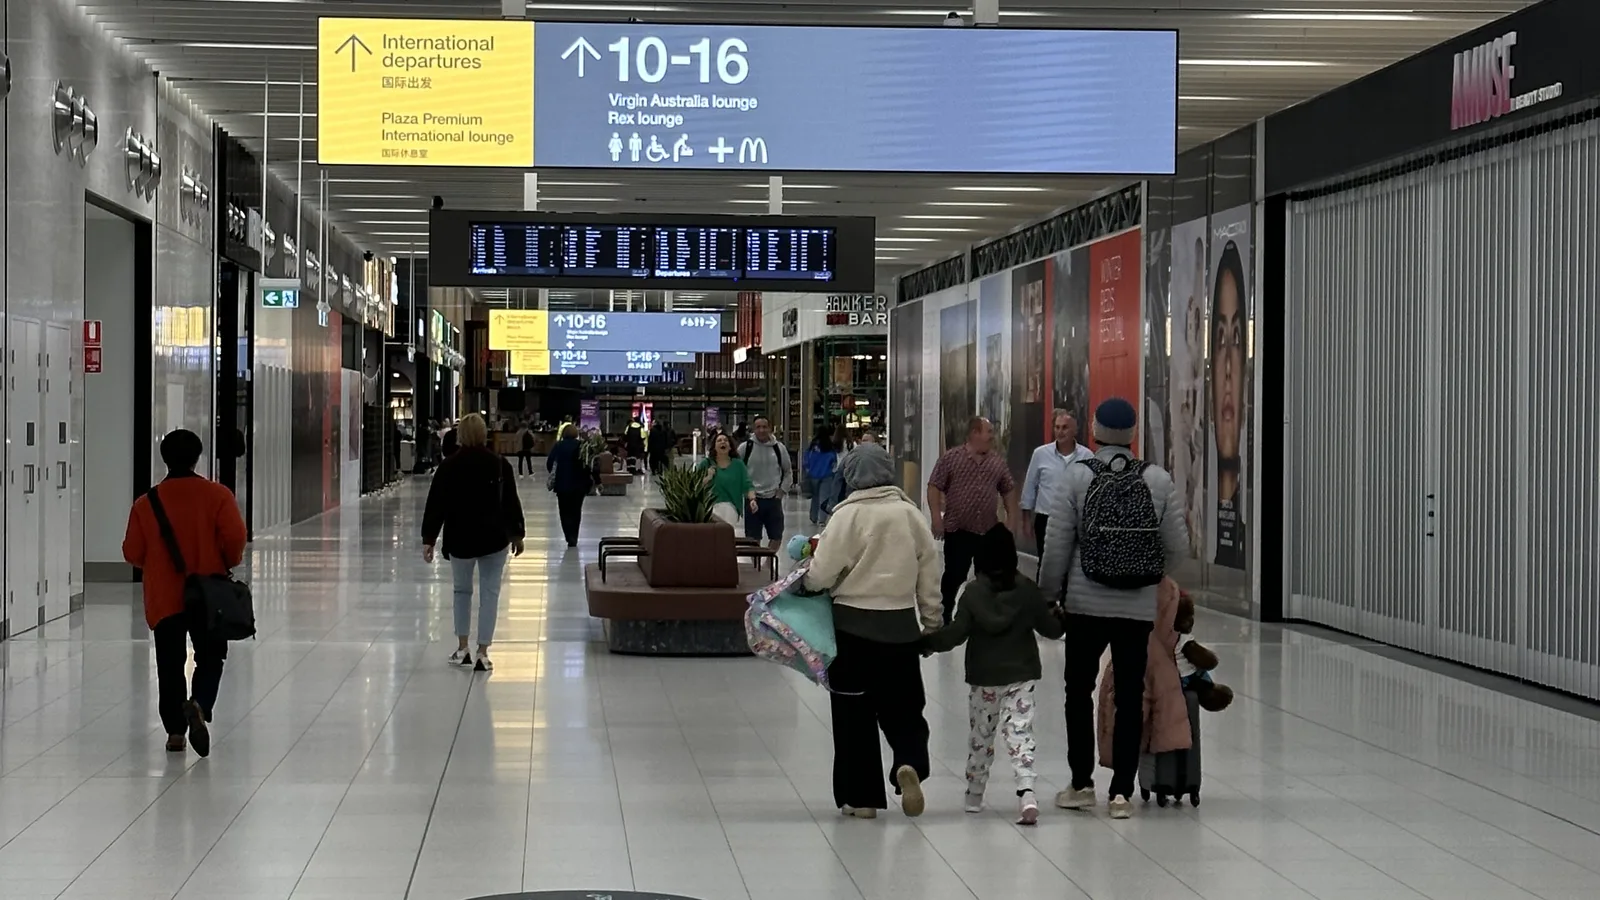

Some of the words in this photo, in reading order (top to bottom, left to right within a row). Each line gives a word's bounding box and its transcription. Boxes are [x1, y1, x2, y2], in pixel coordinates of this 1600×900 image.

[382, 33, 495, 51] International
[382, 53, 482, 71] departures
[608, 36, 749, 85] 10-16
[381, 76, 432, 89] 国际出发
[1450, 31, 1517, 130] AMUSE
[1538, 82, 1563, 102] STUDIO
[608, 93, 648, 109] Virgin
[650, 94, 709, 108] Australia
[712, 95, 758, 111] lounge
[381, 112, 419, 125] Plaza
[423, 113, 483, 125] Premium
[608, 111, 635, 124] Rex
[637, 111, 684, 128] lounge
[381, 129, 465, 142] International
[468, 130, 515, 146] lounge
[381, 148, 429, 159] 国际休息室
[655, 269, 691, 278] Departures
[826, 295, 887, 312] HAWKER
[566, 314, 606, 329] 10-16
[848, 312, 887, 326] BAR
[561, 351, 587, 361] 10-14
[626, 351, 652, 362] 15-16
